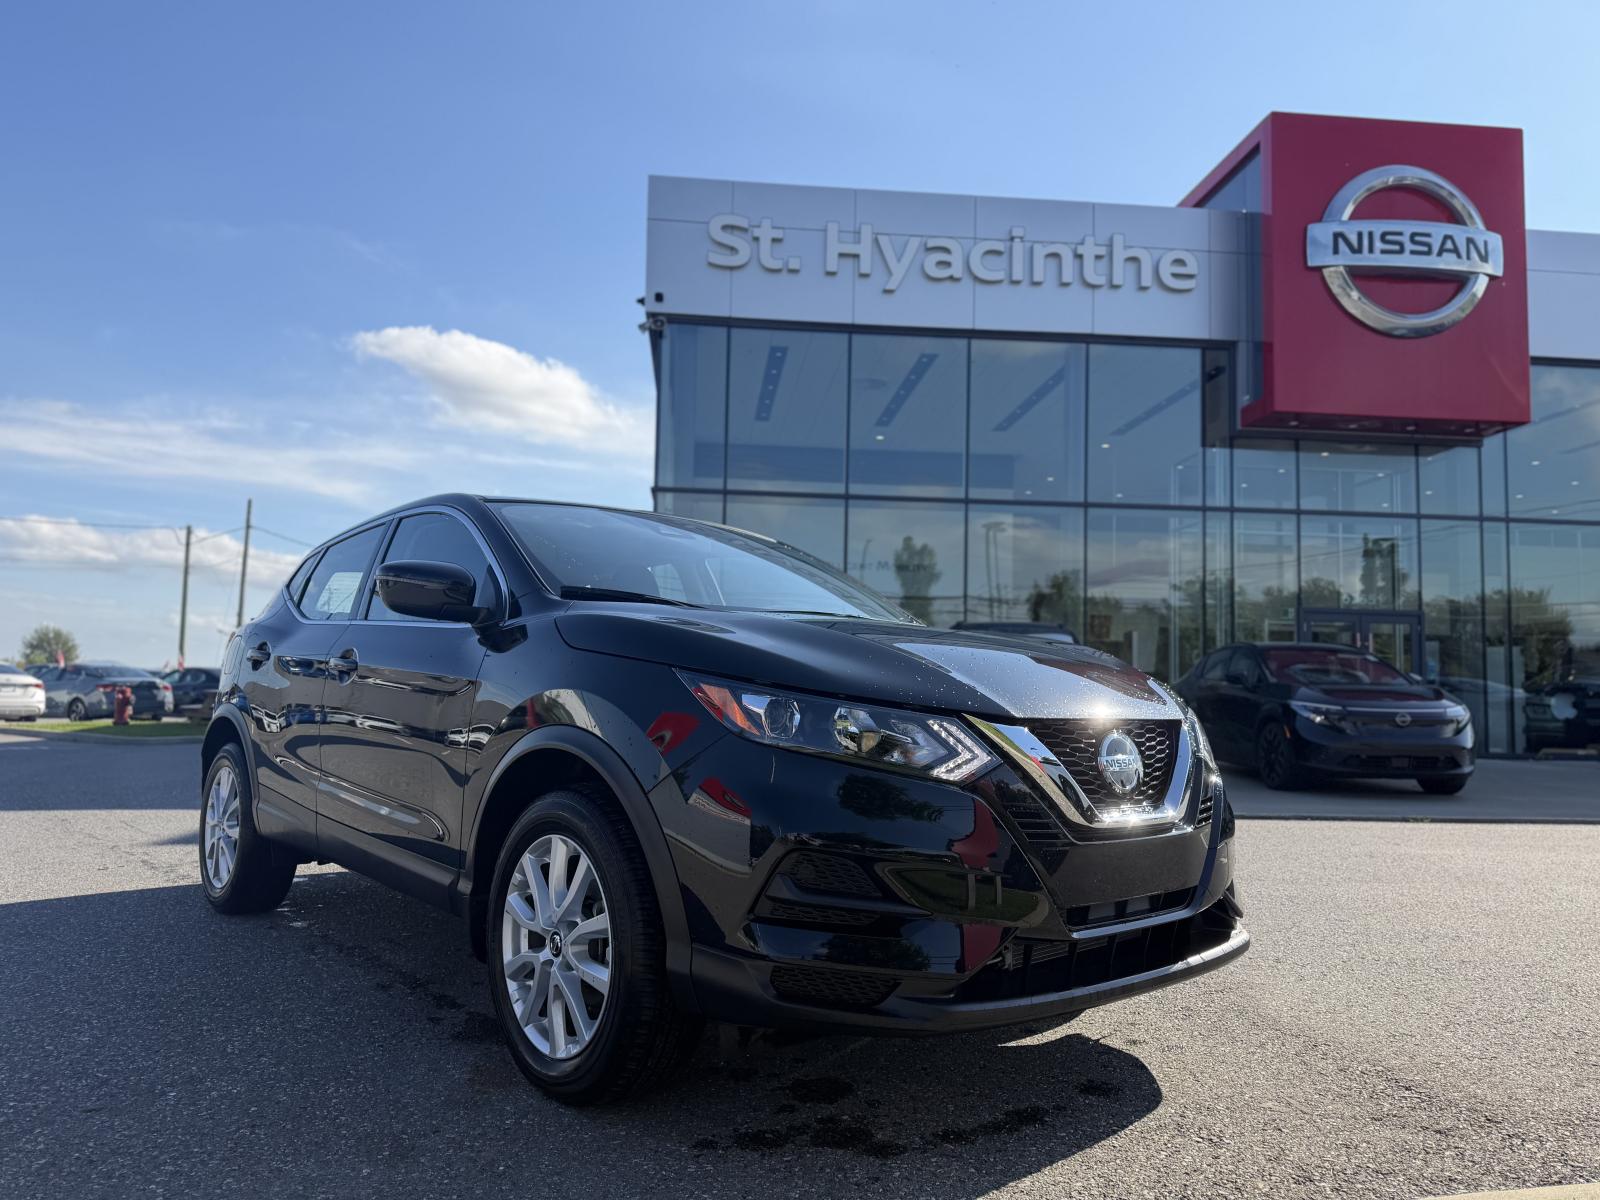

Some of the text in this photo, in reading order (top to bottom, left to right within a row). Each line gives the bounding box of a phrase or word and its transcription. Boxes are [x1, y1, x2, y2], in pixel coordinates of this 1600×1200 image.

[707, 213, 1198, 294] St. Hyacinthe
[1332, 230, 1490, 264] NISSAN
